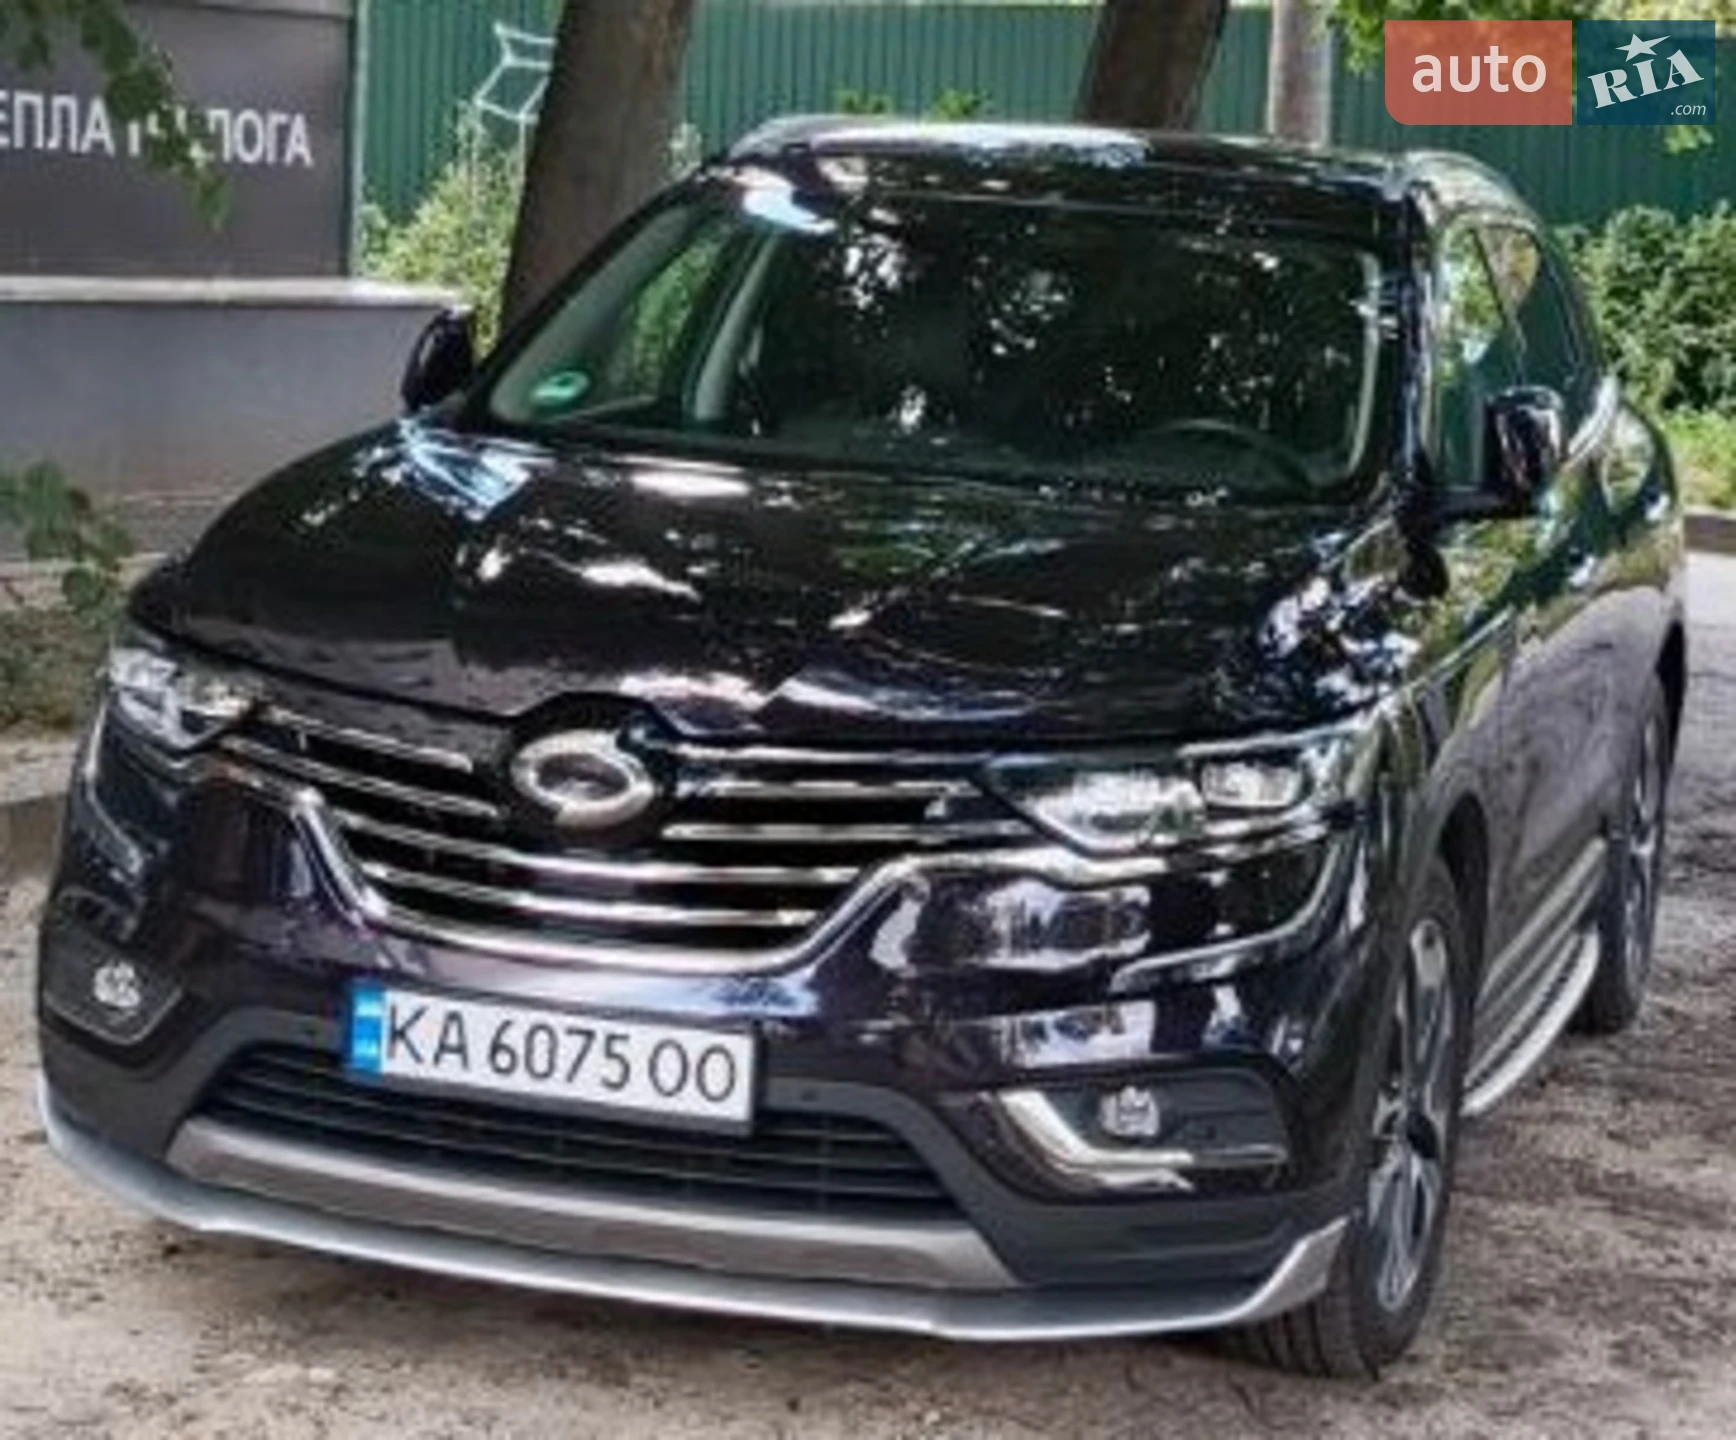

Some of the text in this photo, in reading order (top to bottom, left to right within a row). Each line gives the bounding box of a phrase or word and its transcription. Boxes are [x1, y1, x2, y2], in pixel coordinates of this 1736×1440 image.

[127, 104, 313, 168] ЛОГА
[386, 1002, 471, 1072] KA
[487, 1019, 632, 1092] 6075
